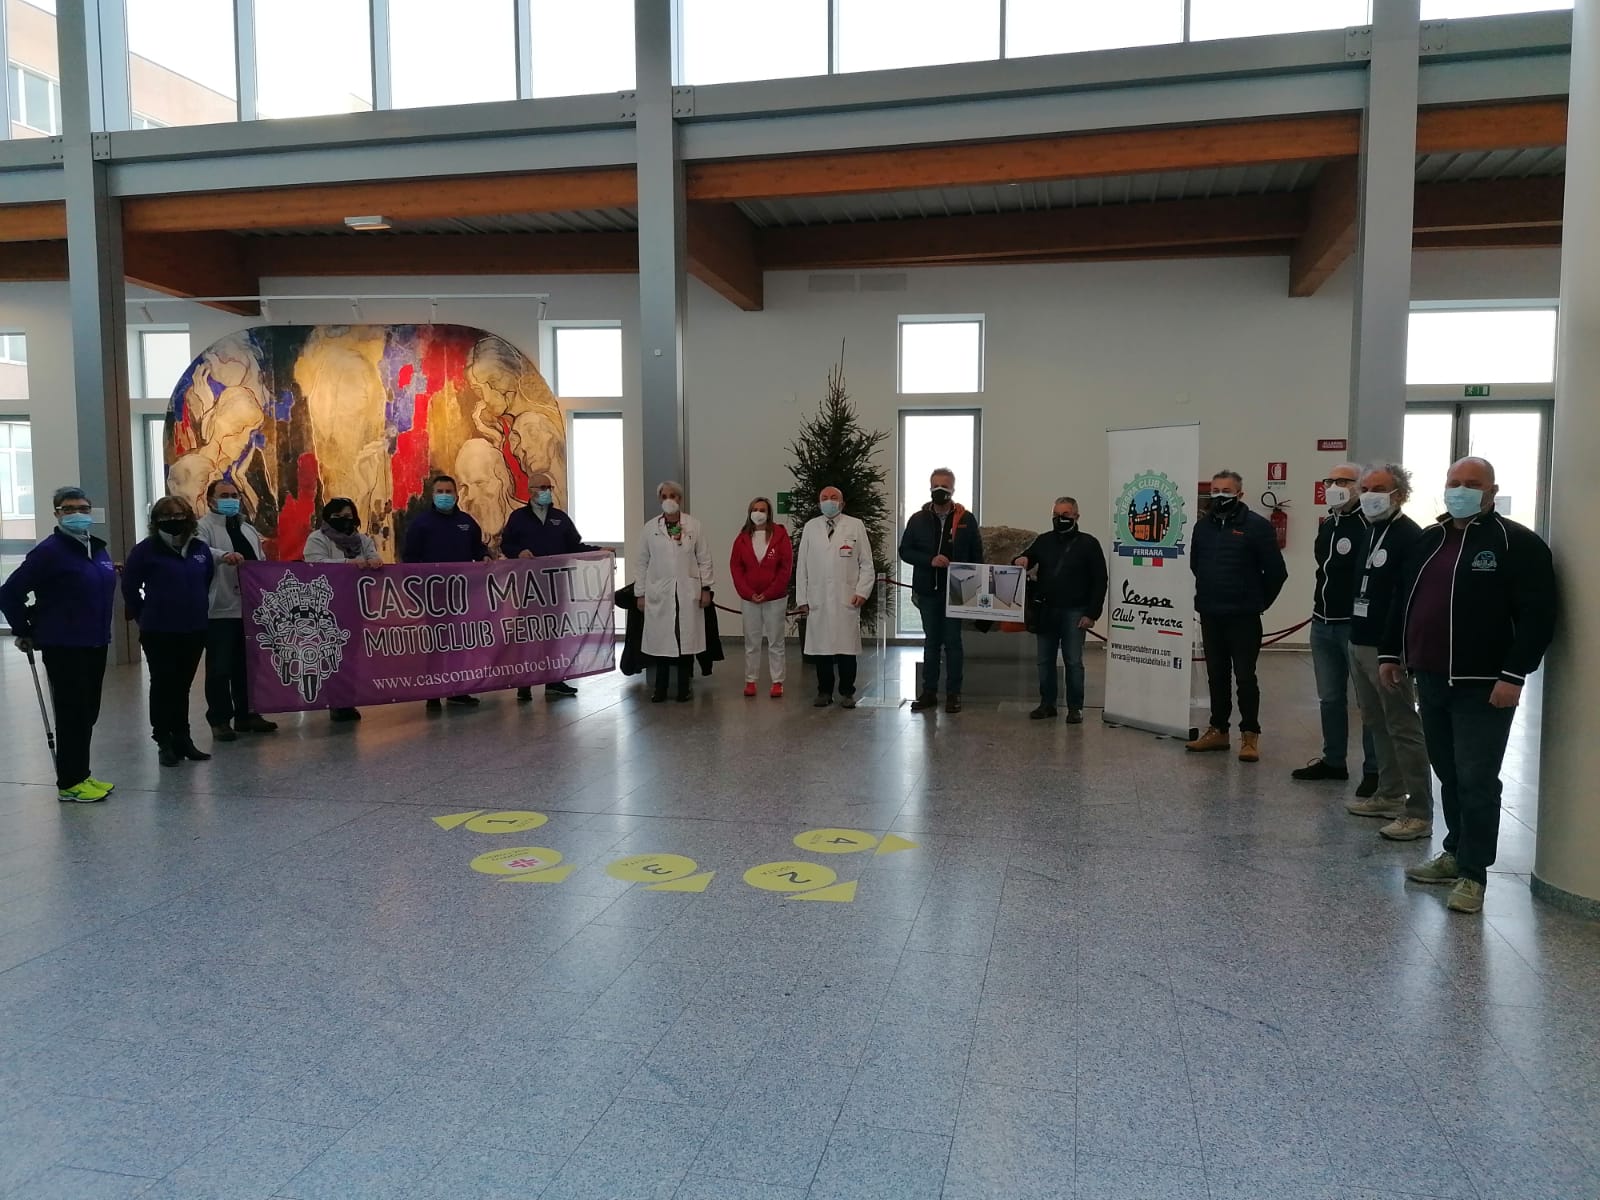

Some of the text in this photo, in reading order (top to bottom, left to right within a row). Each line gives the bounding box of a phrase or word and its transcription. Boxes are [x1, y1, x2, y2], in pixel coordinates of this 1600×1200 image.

[1120, 480, 1178, 515] VESPA CLUB ITALIA
[1133, 549, 1163, 557] FERRARA
[357, 565, 603, 620] CASCO MATTO
[1122, 579, 1174, 609] Vespa
[1112, 608, 1184, 629] Club Ferrara
[363, 610, 607, 658] MOTOCLUB FERRARA
[826, 836, 858, 845] 4
[642, 863, 673, 875] 3
[777, 871, 812, 884] 2
